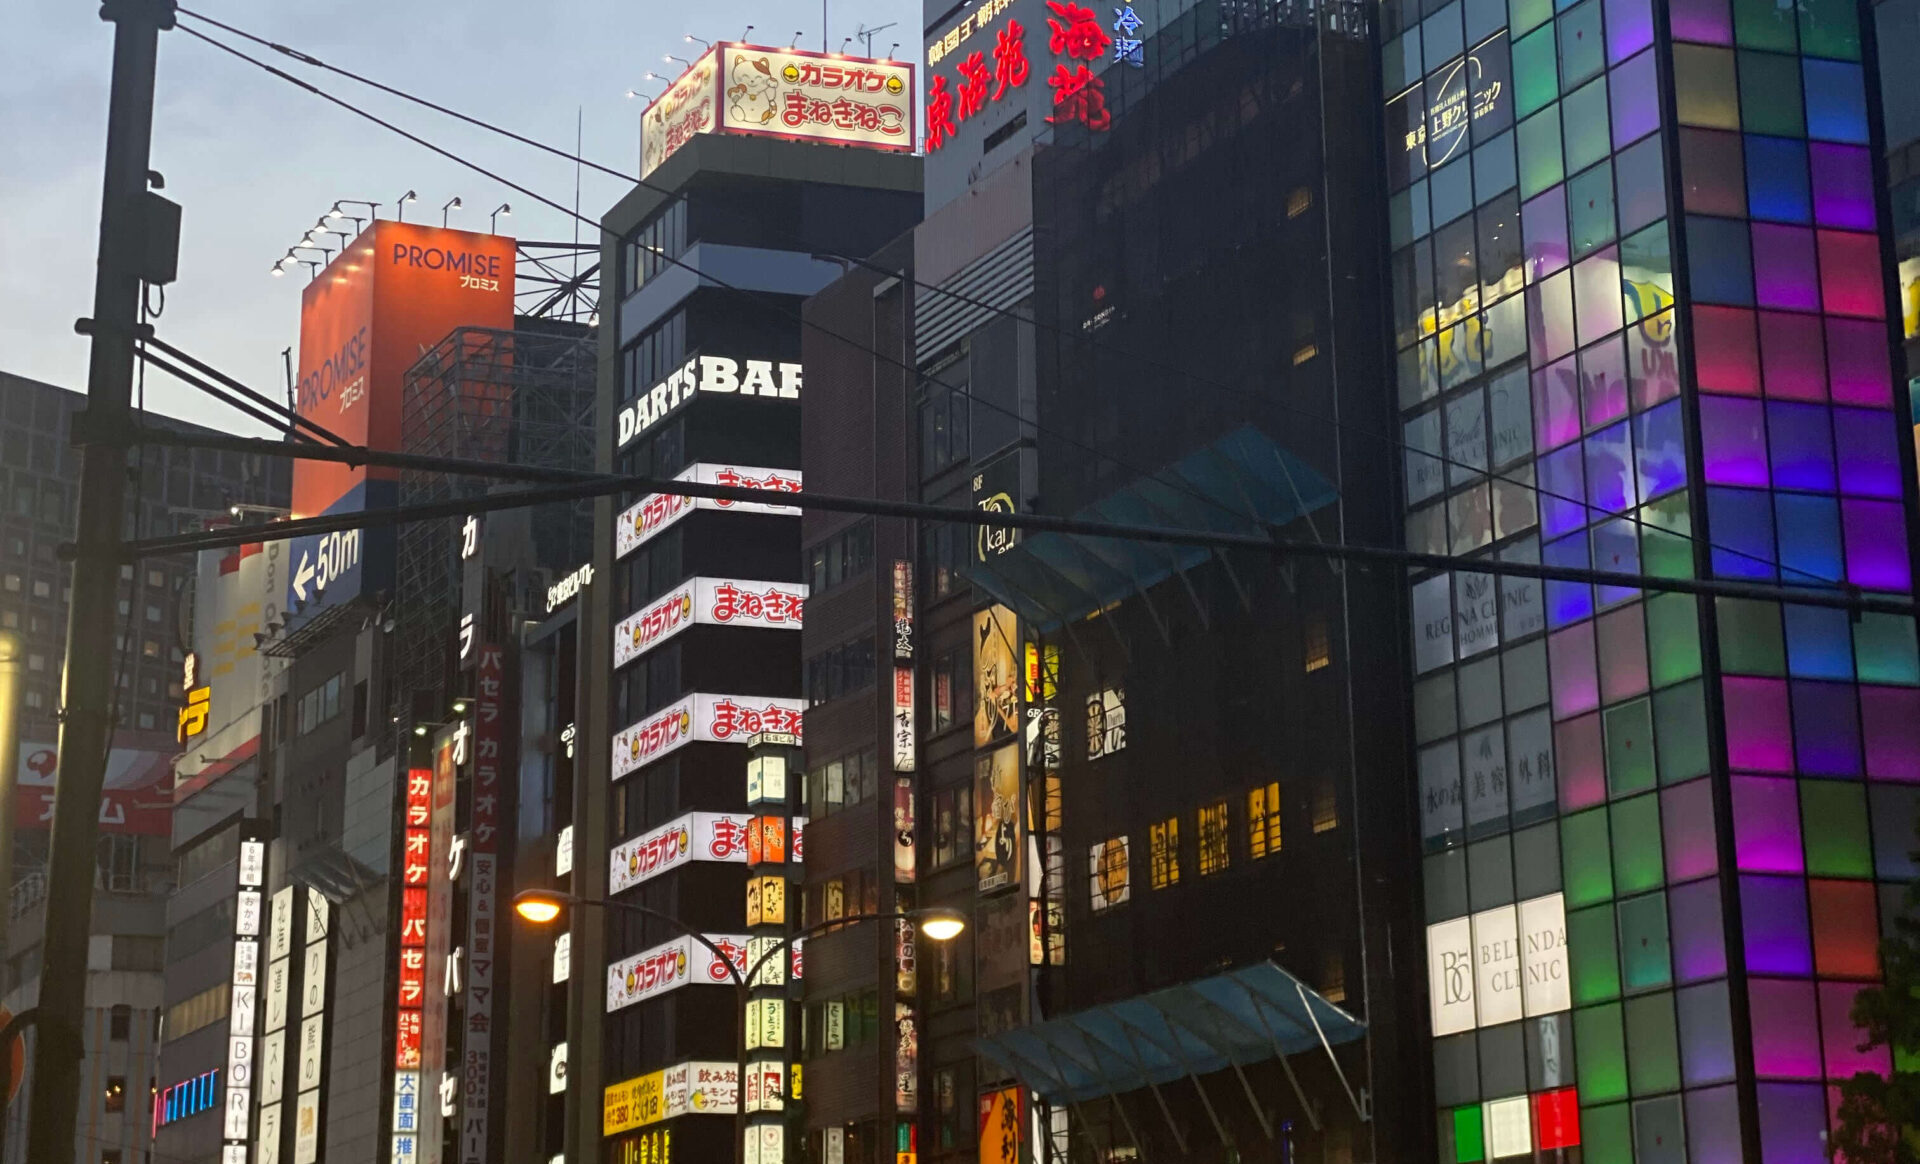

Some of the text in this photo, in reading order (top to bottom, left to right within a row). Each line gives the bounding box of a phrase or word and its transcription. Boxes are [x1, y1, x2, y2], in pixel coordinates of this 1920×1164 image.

[799, 63, 887, 92] カラオケ
[925, 18, 1029, 153] 東海苑
[782, 91, 904, 135] まねきねこ
[393, 243, 500, 278] PROMISE
[459, 274, 499, 292] プロミス
[301, 326, 366, 411] PROMISE
[339, 376, 364, 415] プロミス
[618, 358, 697, 447] DARTS
[642, 493, 683, 532] カラオケ
[316, 529, 358, 590] 50m
[640, 596, 683, 644] カラオケ
[475, 652, 502, 843] パセラ カラオケ
[638, 712, 682, 757] カラオケ
[896, 709, 912, 748] 吉宗
[897, 752, 914, 770] 7F
[636, 830, 680, 873] カラオケ
[402, 776, 430, 1000] カラオケ パセラ
[244, 897, 255, 931] おかか
[1482, 927, 1567, 964] BELINDA
[634, 950, 678, 992] カラオケ
[1491, 959, 1561, 993] CLINIC
[400, 1013, 409, 1048] ハニトー
[410, 1013, 419, 1034] 名物
[231, 991, 250, 1133] KIBORI
[700, 1099, 729, 1108] サワー
[701, 1087, 728, 1096] レモン
